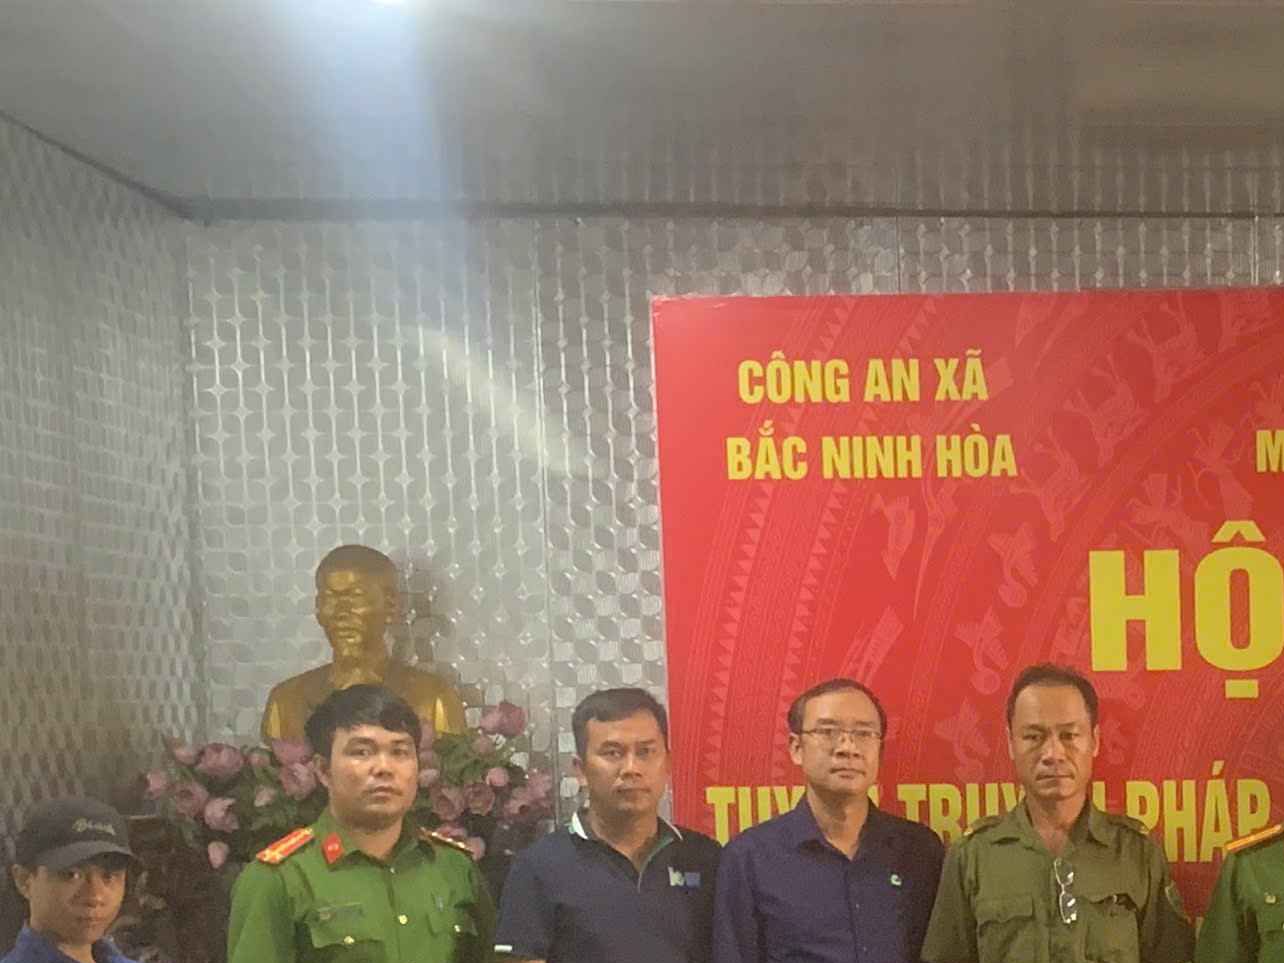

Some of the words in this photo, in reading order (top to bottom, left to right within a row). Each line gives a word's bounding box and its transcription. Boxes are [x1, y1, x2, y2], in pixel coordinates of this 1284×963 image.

[739, 350, 851, 405] CÔNG
[865, 360, 921, 404] AN
[935, 348, 989, 402] XÃ
[727, 420, 810, 482] BẮC
[822, 436, 924, 480] NINH
[936, 424, 1018, 479] HÒA
[1126, 760, 1271, 863] PHÁP
